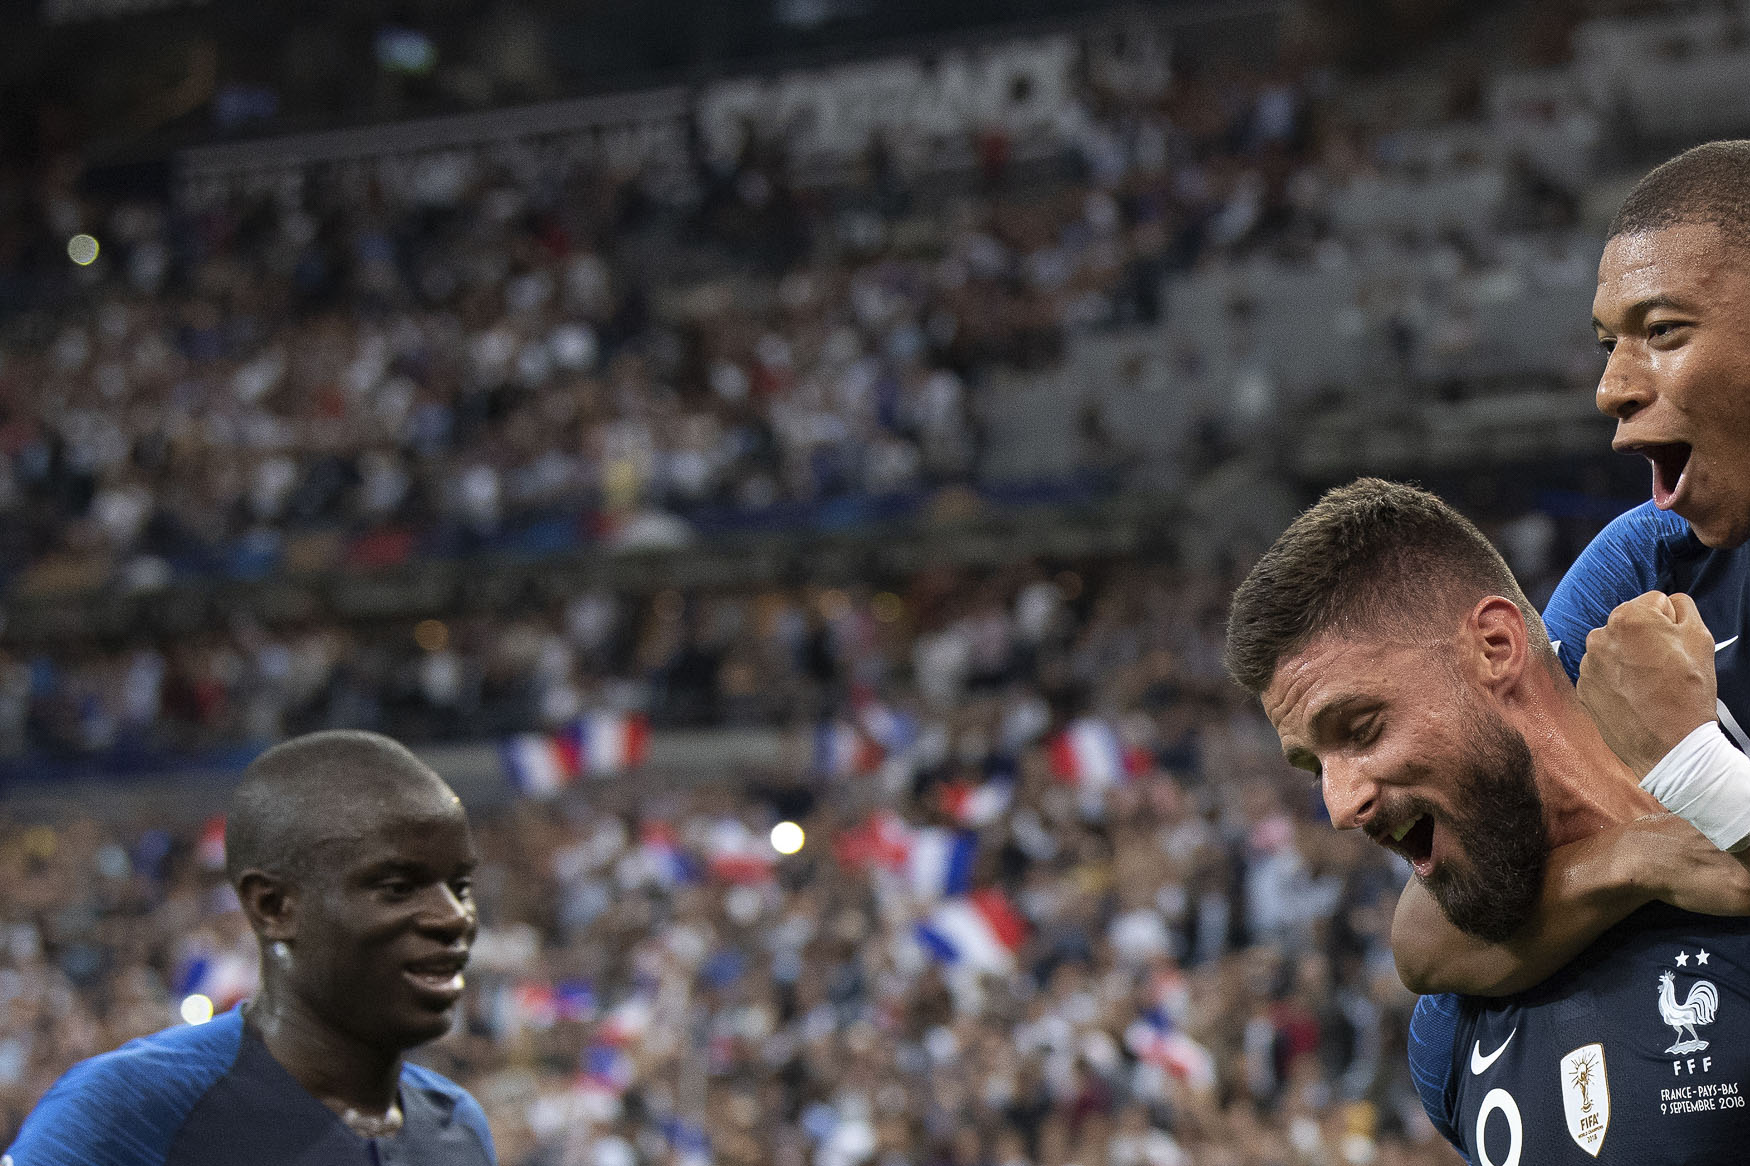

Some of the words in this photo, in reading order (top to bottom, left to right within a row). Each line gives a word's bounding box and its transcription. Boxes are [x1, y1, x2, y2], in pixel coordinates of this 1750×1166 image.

[1660, 1103, 1667, 1115] 9
[1669, 1098, 1716, 1115] SEPTEMBRE
[1717, 1096, 1746, 1110] 2018
[1580, 1113, 1599, 1131] FIFA
